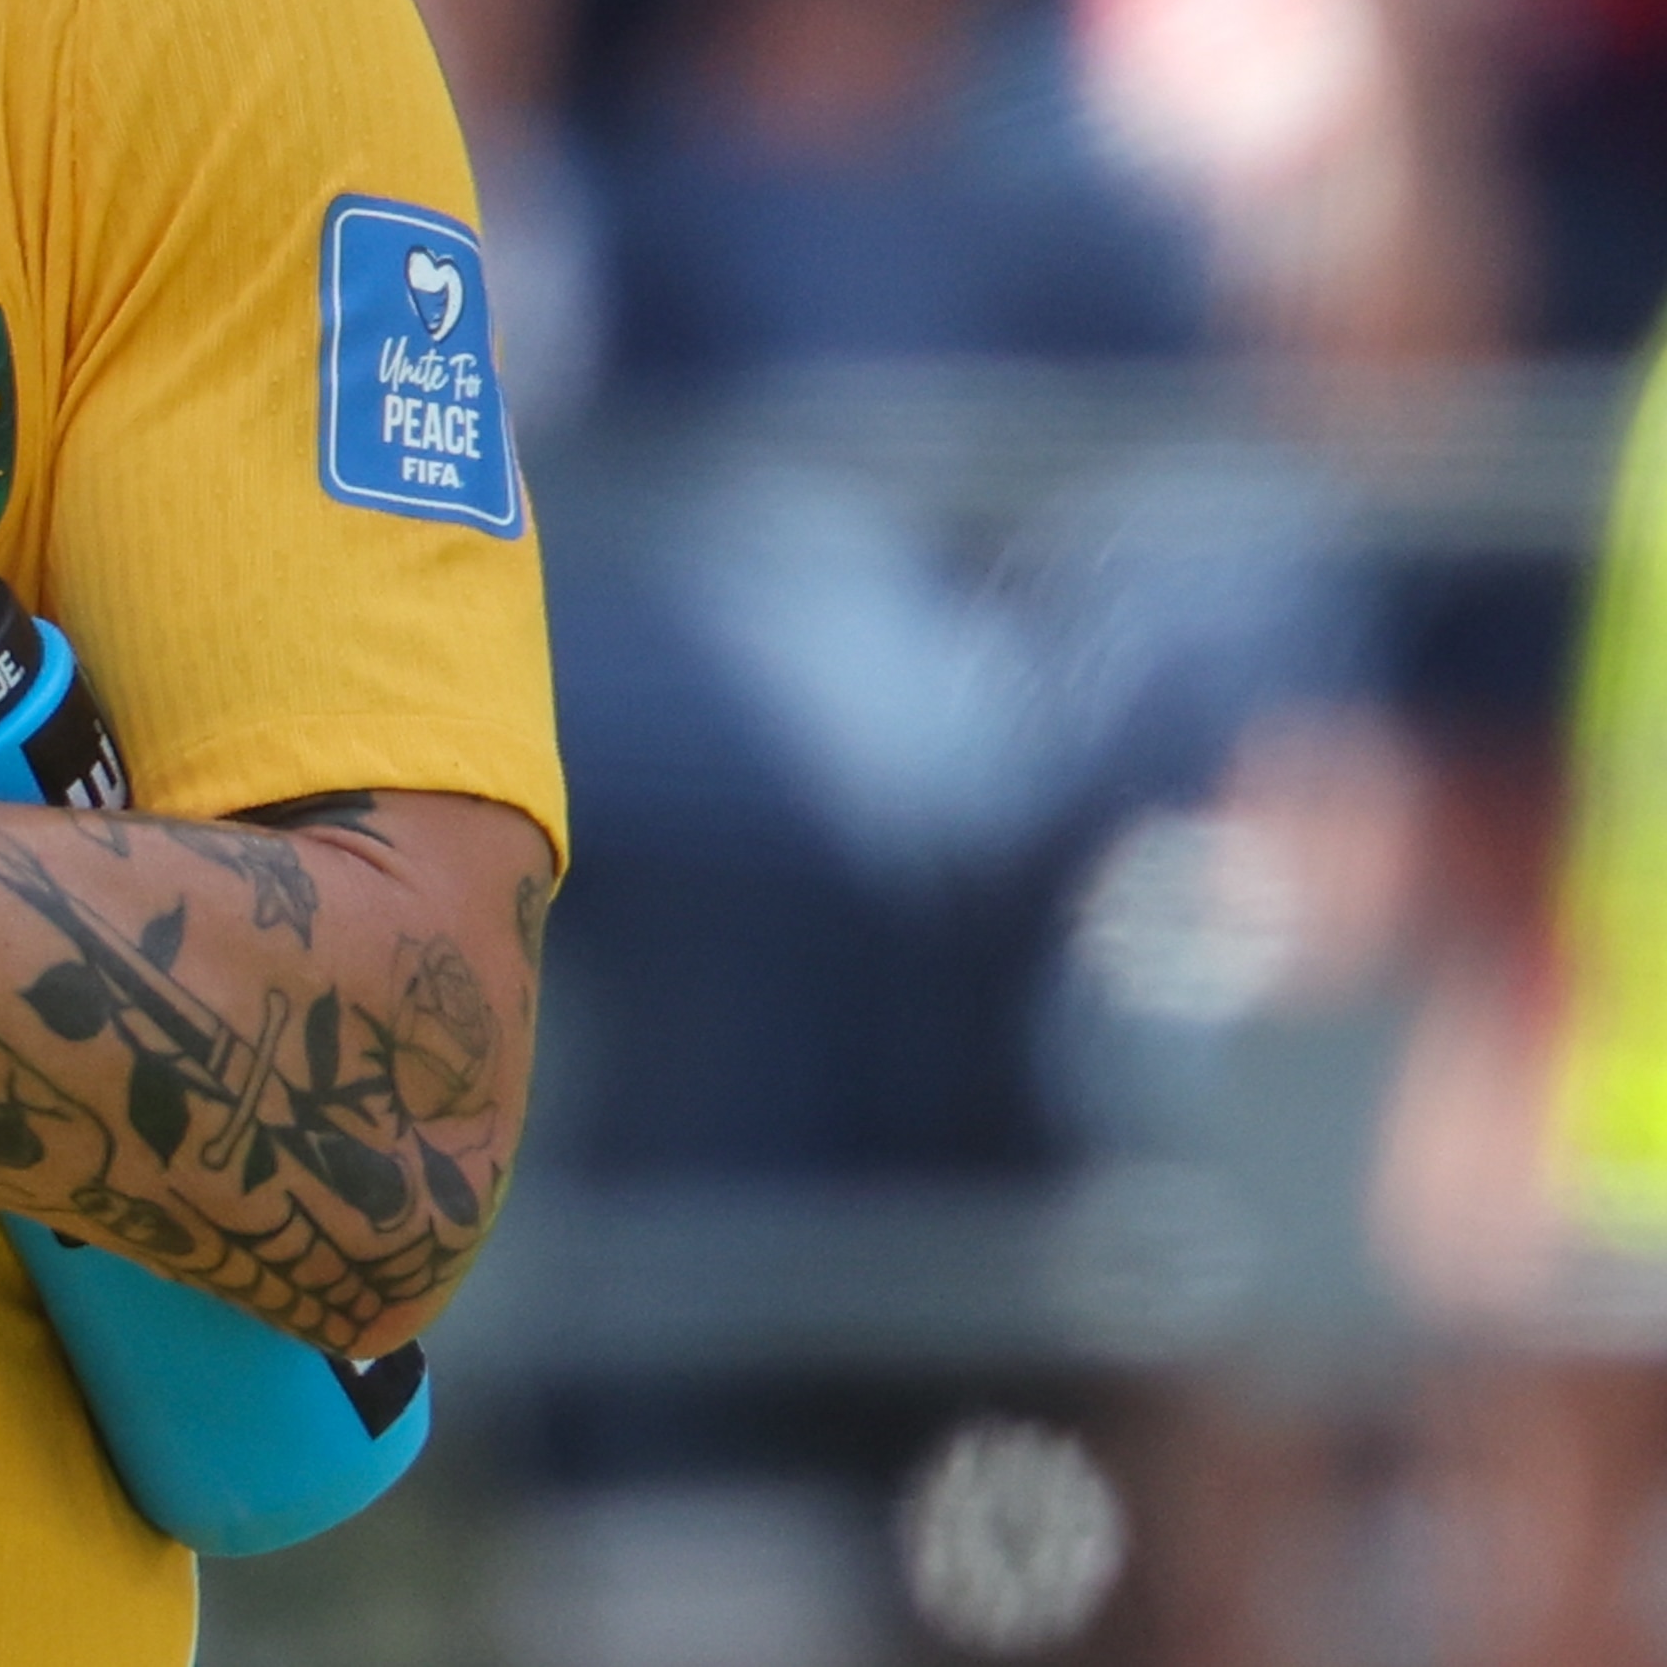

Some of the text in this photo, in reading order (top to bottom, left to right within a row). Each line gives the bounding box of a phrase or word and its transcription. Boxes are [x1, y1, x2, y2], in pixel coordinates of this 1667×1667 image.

[378, 335, 450, 394] Unite
[382, 394, 482, 460] PEACE
[401, 456, 462, 489] FIFA
